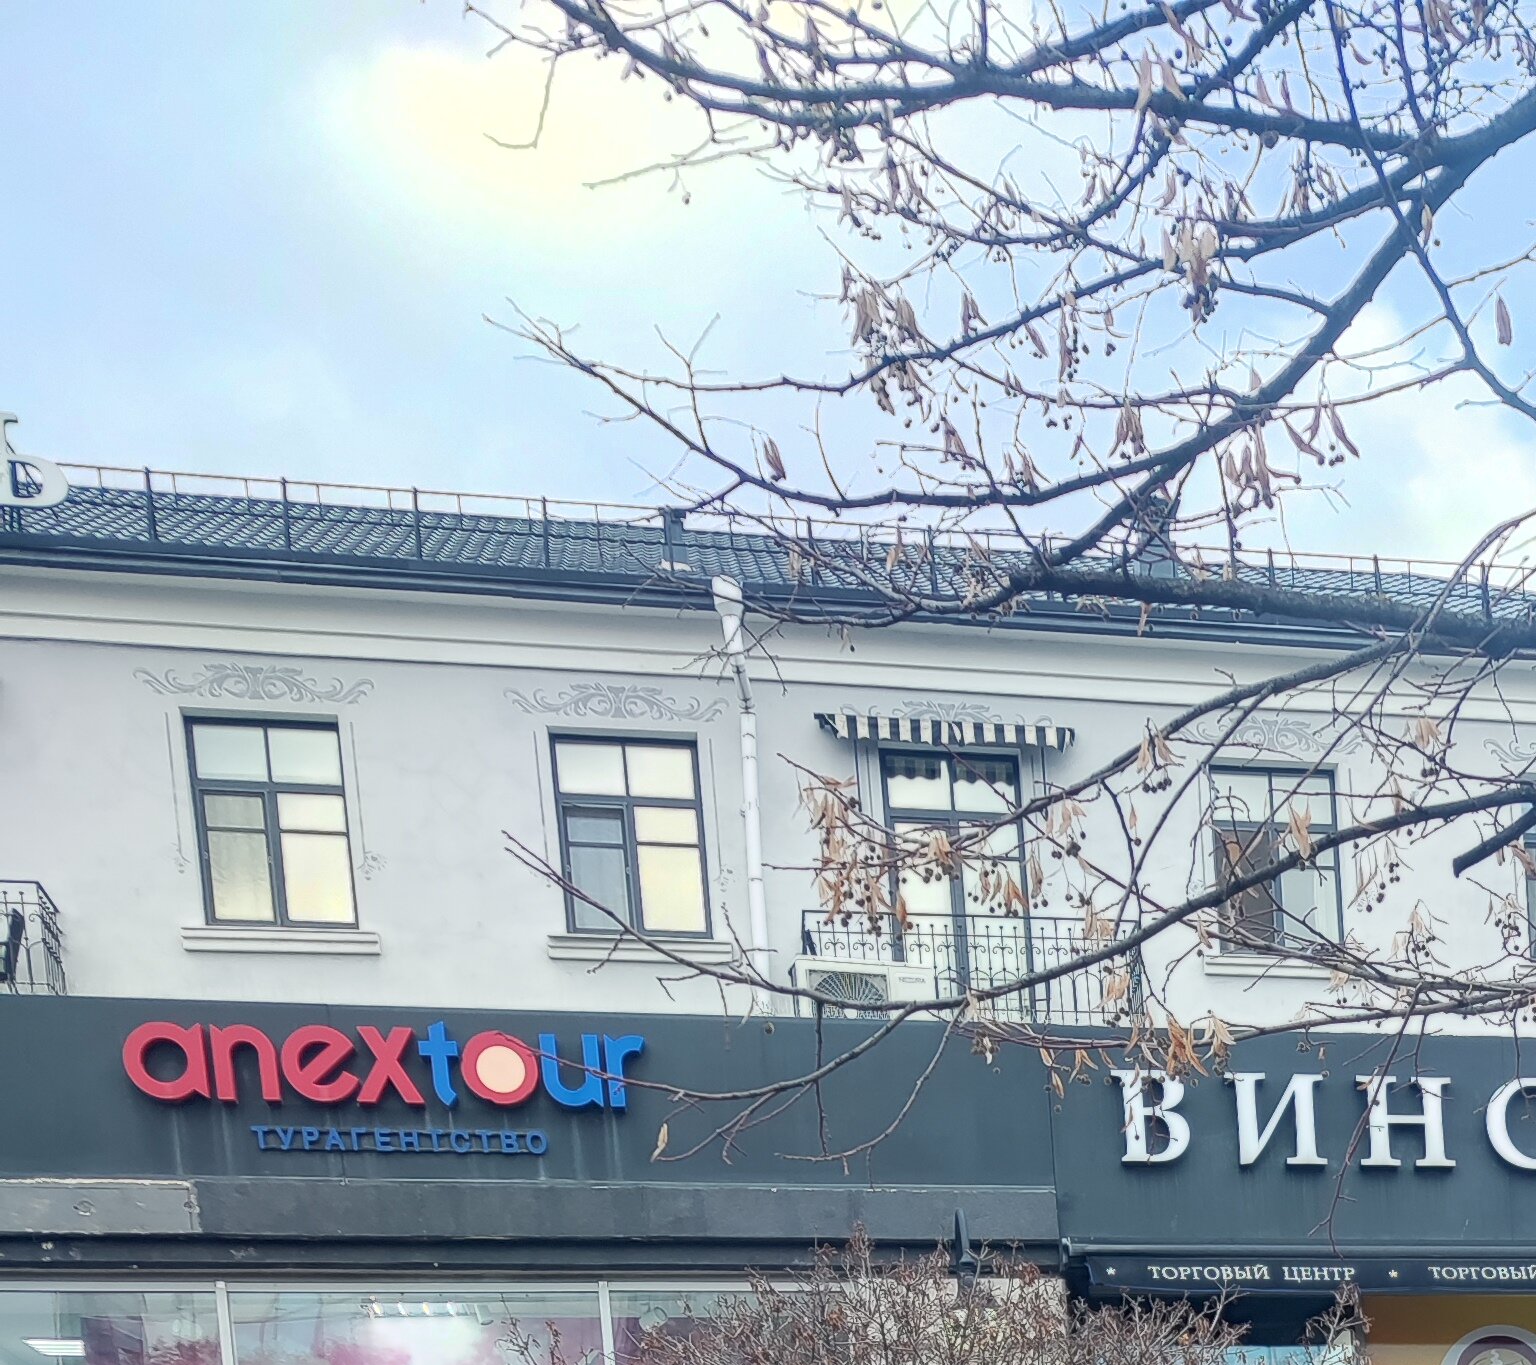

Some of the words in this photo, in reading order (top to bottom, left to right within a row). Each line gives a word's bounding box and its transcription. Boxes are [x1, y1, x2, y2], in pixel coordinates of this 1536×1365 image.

[123, 1021, 645, 1108] anextour
[251, 1125, 549, 1155] ТУРАГЕНТСТВО
[1148, 1264, 1270, 1281] ТОРГОВЫЙ
[1282, 1266, 1355, 1282] ЦЕНТР
